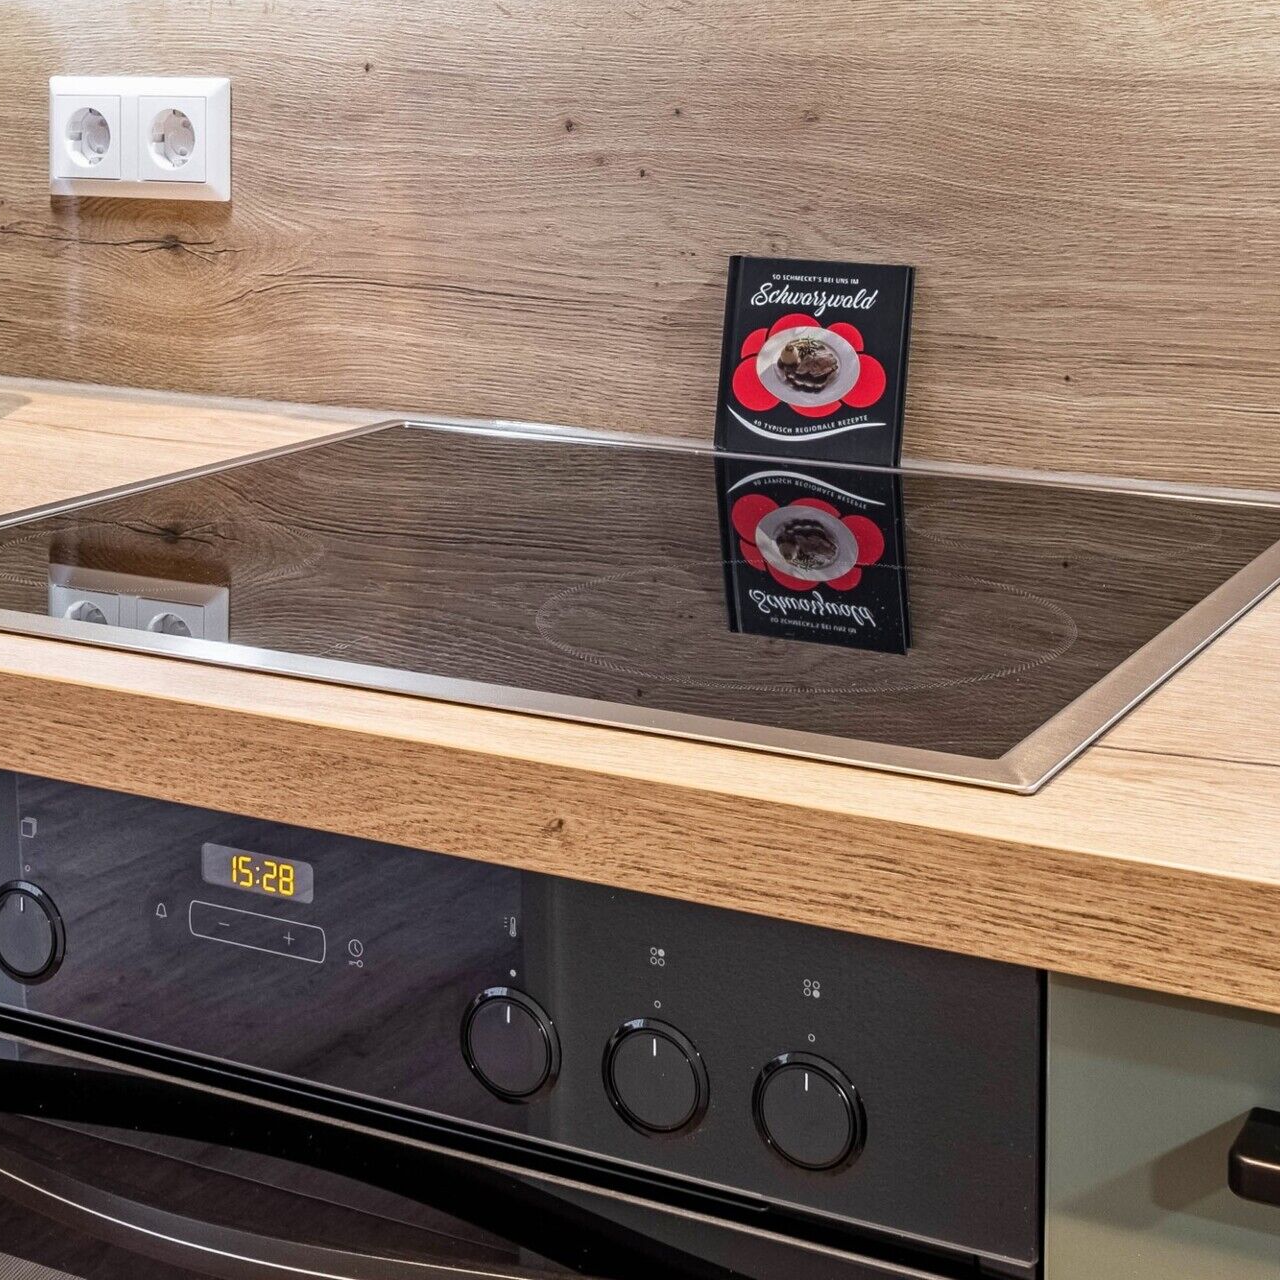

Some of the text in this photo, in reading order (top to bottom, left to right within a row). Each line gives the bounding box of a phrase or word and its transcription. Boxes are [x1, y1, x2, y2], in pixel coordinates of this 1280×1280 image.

[782, 274, 822, 282] SCHMECKT'S
[750, 282, 879, 317] Schwarzwald
[764, 422, 793, 434] TYPISCH
[795, 423, 836, 434] REGIONALE
[837, 414, 869, 427] REZEPTE
[231, 855, 295, 897] 15:28
